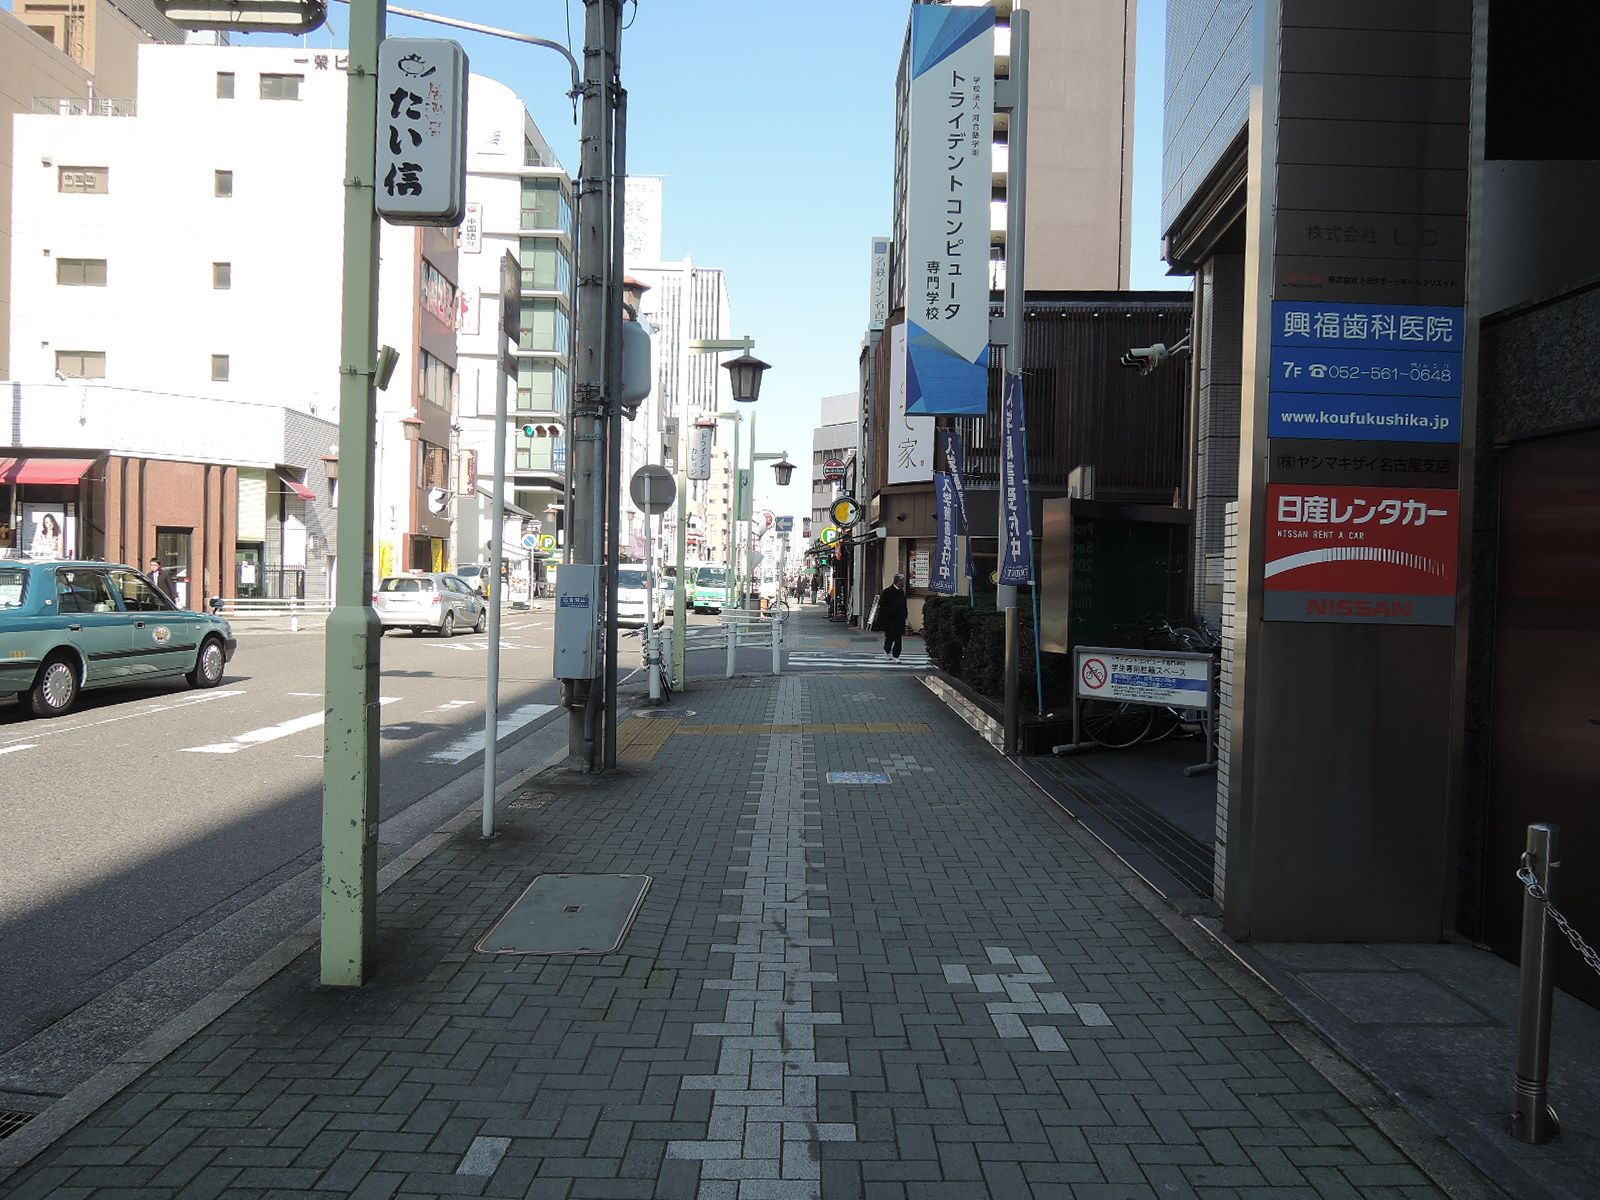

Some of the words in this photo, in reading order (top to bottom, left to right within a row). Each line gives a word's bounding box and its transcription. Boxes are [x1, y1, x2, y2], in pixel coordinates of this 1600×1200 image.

[972, 76, 981, 110] 学校法人
[384, 87, 424, 196] たい信
[945, 70, 966, 320] トライデントコンピュータ
[1306, 224, 1378, 243] 株式会社
[926, 260, 940, 320] 専門学校
[1284, 311, 1453, 342] 興福歯科医院
[1283, 361, 1302, 378] 7F
[1328, 365, 1451, 382] 052-561-0648
[1281, 411, 1449, 429] www.koufukushika.jp
[1277, 495, 1448, 526] 日産レンタカー
[1277, 529, 1309, 539] NISSAN
[1313, 530, 1333, 539] RENT
[1338, 531, 1344, 539] A
[1348, 531, 1365, 540] CAR
[1307, 597, 1413, 618] NISSAN
